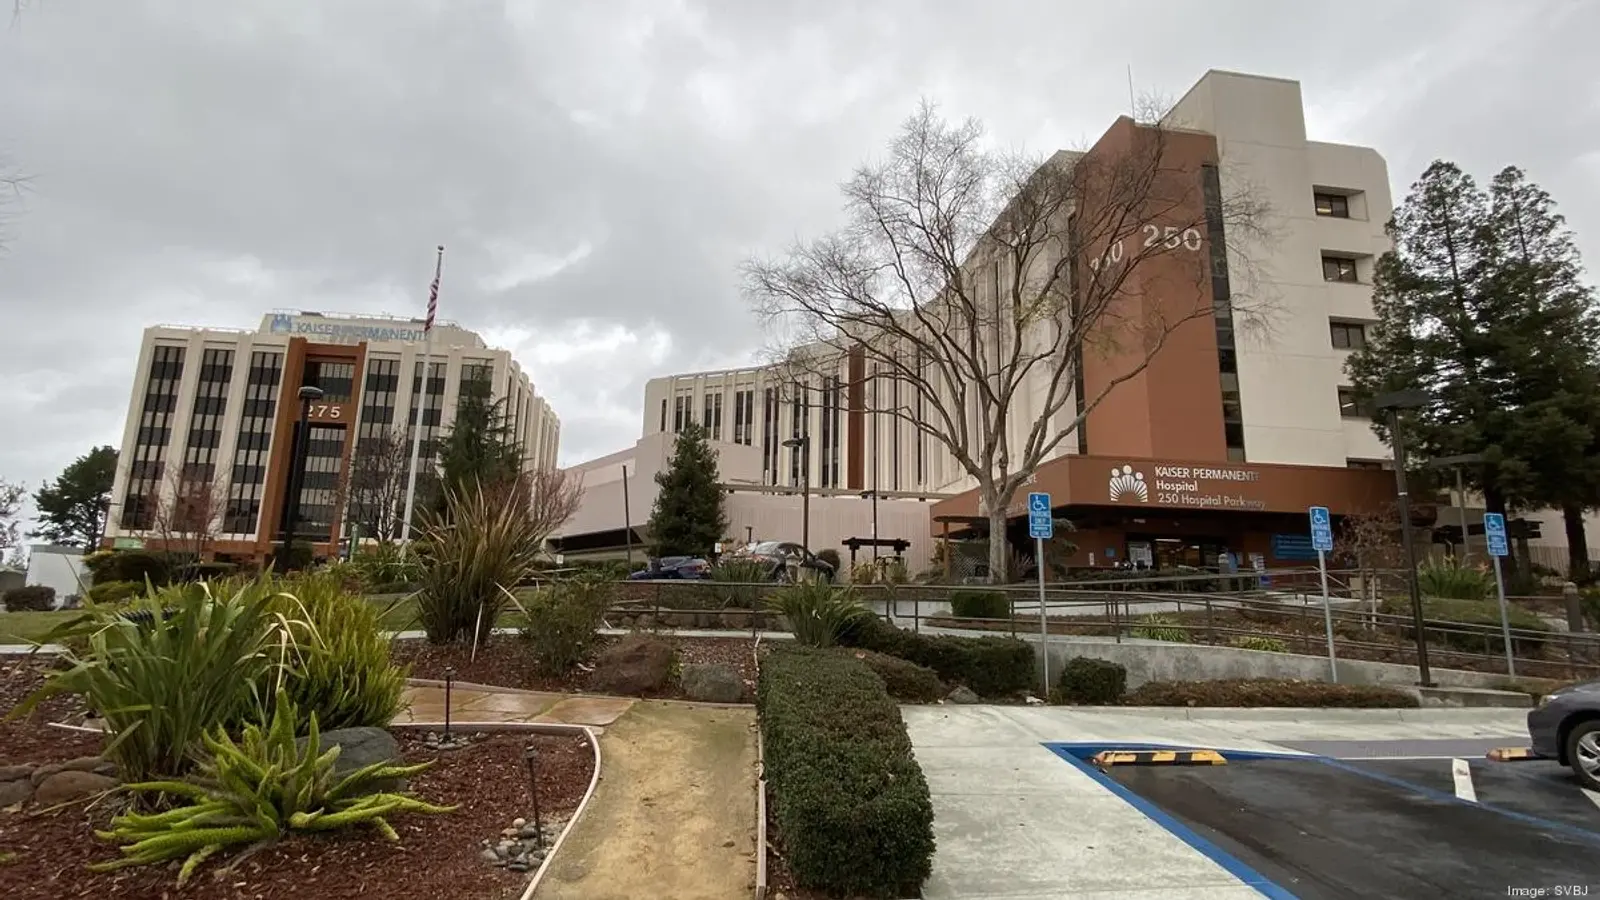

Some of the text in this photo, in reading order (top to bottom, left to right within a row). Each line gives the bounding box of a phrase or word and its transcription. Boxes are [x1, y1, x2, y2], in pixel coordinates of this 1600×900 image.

[1143, 224, 1201, 251] 250
[297, 323, 428, 341] KAISER PERMANENT
[1154, 466, 1190, 479] KAISER
[1156, 480, 1198, 493] Hospital
[1158, 493, 1179, 503] 250
[1181, 495, 1221, 508] Hospital
